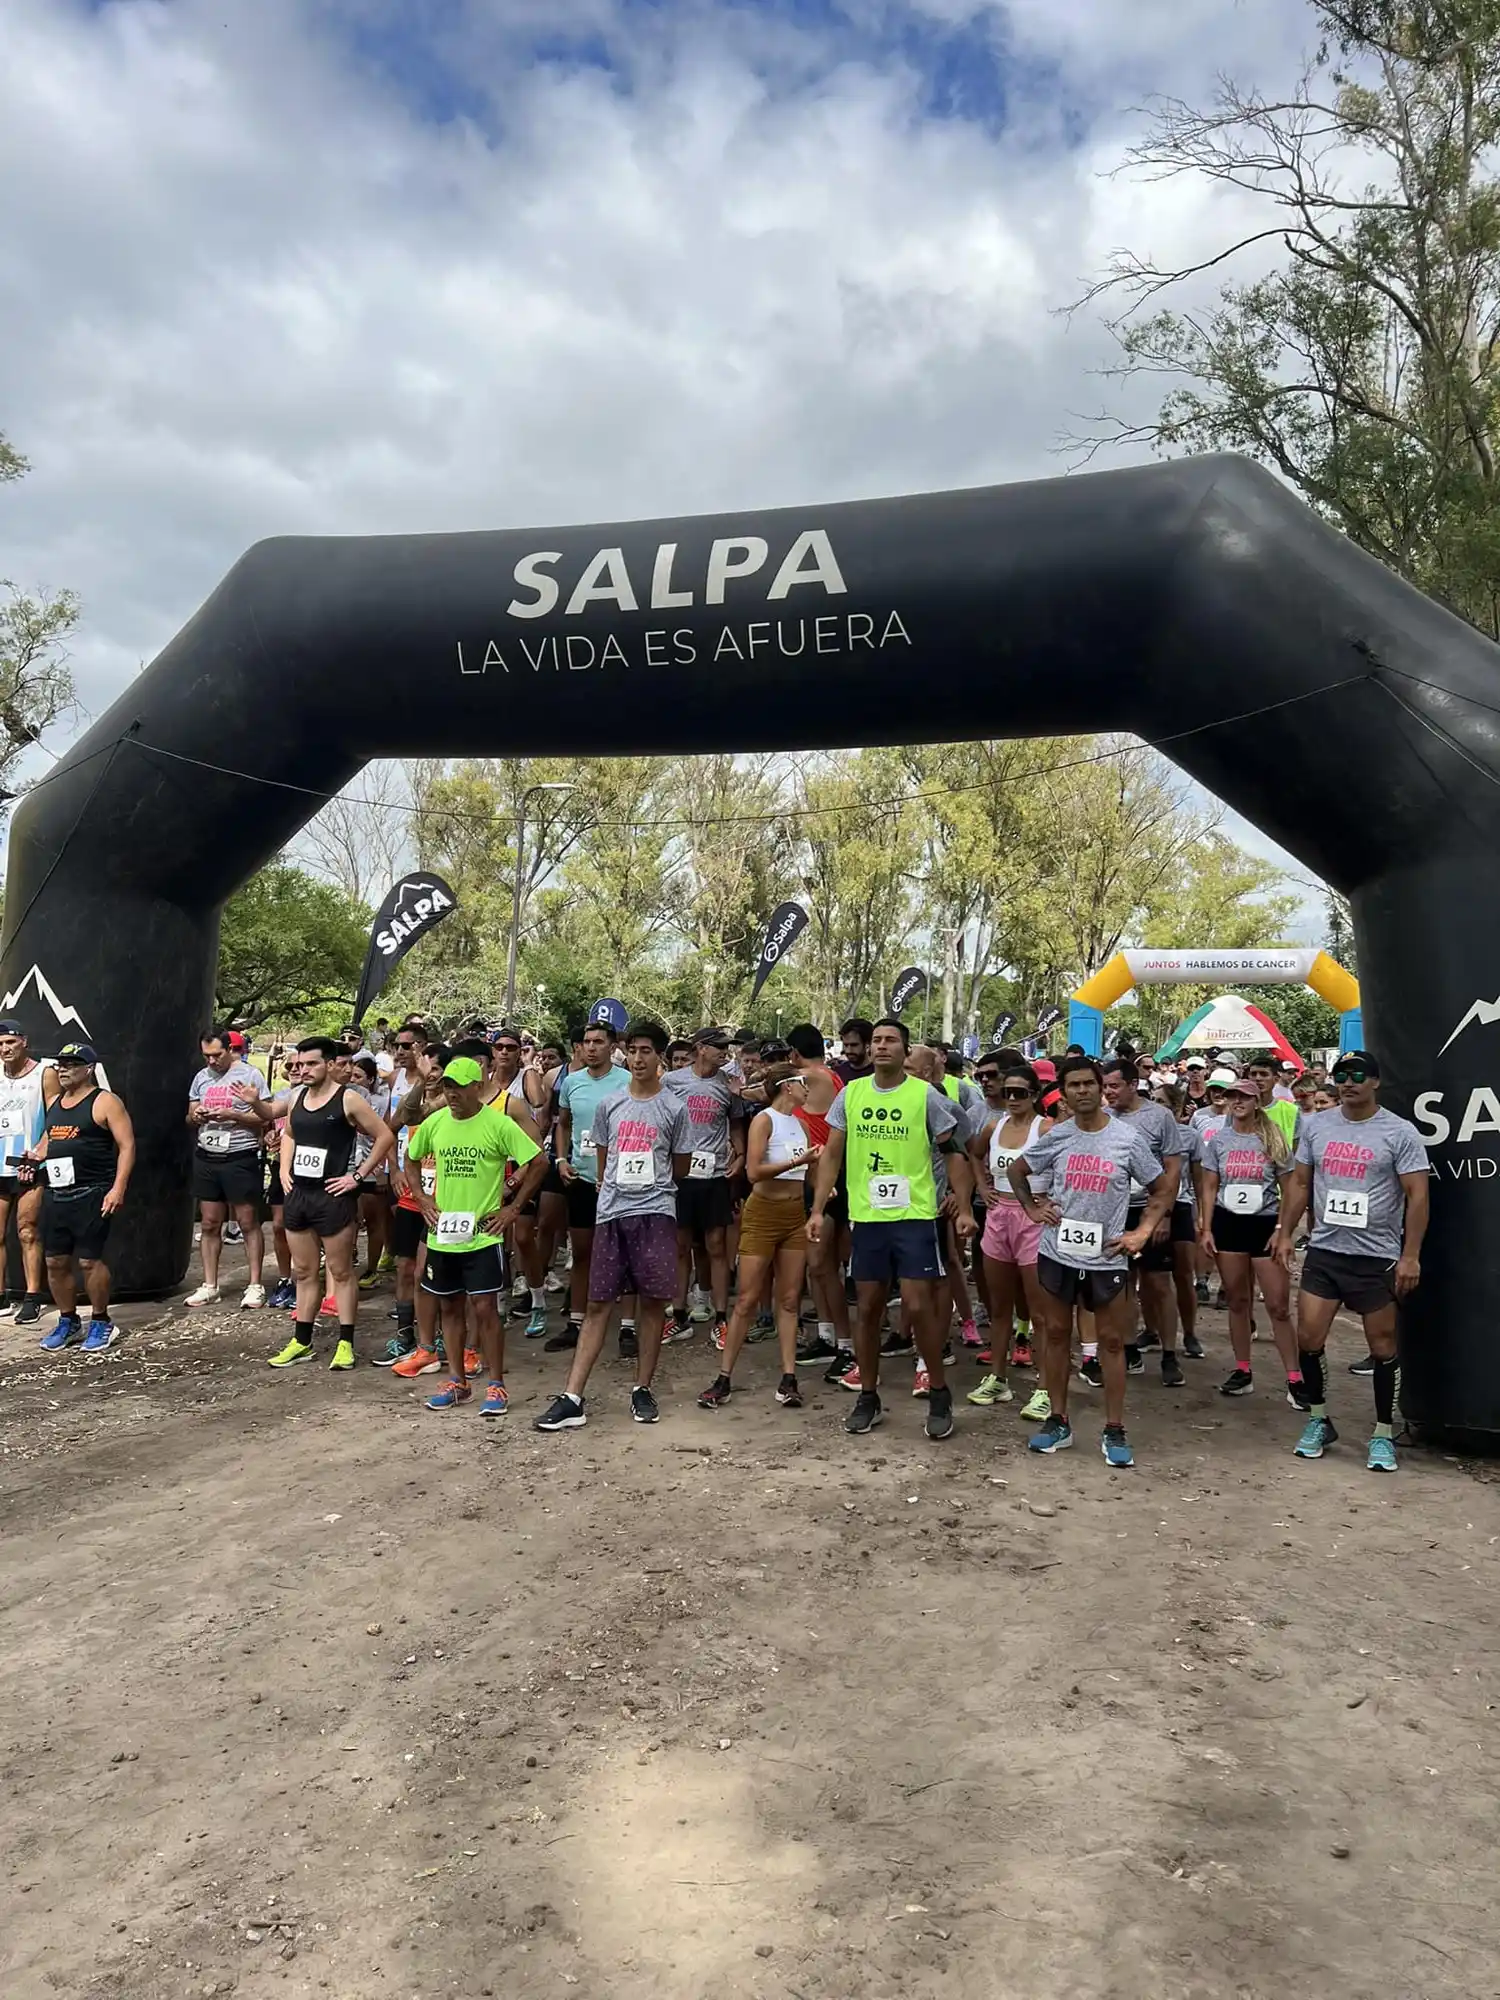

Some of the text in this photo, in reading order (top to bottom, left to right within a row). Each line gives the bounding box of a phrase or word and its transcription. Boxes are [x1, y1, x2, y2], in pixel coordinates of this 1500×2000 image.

[507, 529, 848, 619] SALPA
[457, 610, 912, 675] LA VIDA ES AFUERA
[376, 889, 452, 955] SALPA
[773, 912, 797, 944] Salpa
[1144, 960, 1296, 969] JUNTOS HABLEMOS DE CANCER
[897, 975, 919, 999] Salpa
[617, 1120, 647, 1137] ROSA
[856, 1124, 909, 1135] ANGELINI
[206, 1135, 220, 1147] 21
[1226, 1150, 1256, 1163] ROSA
[1324, 1141, 1360, 1160] ROSA
[296, 1154, 320, 1168] 108
[454, 1158, 476, 1166] Santa
[625, 1160, 645, 1174] 17
[691, 1157, 706, 1170] 74
[1066, 1154, 1102, 1172] ROSA
[1321, 1158, 1368, 1180] POWER
[1447, 1157, 1500, 1179] VID
[53, 1165, 61, 1178] 3
[1226, 1164, 1264, 1180] POWER
[878, 1183, 898, 1198] 97
[1064, 1173, 1109, 1193] POWER
[1237, 1191, 1248, 1204] 2
[1328, 1199, 1363, 1216] 111
[1060, 1228, 1096, 1247] 134
